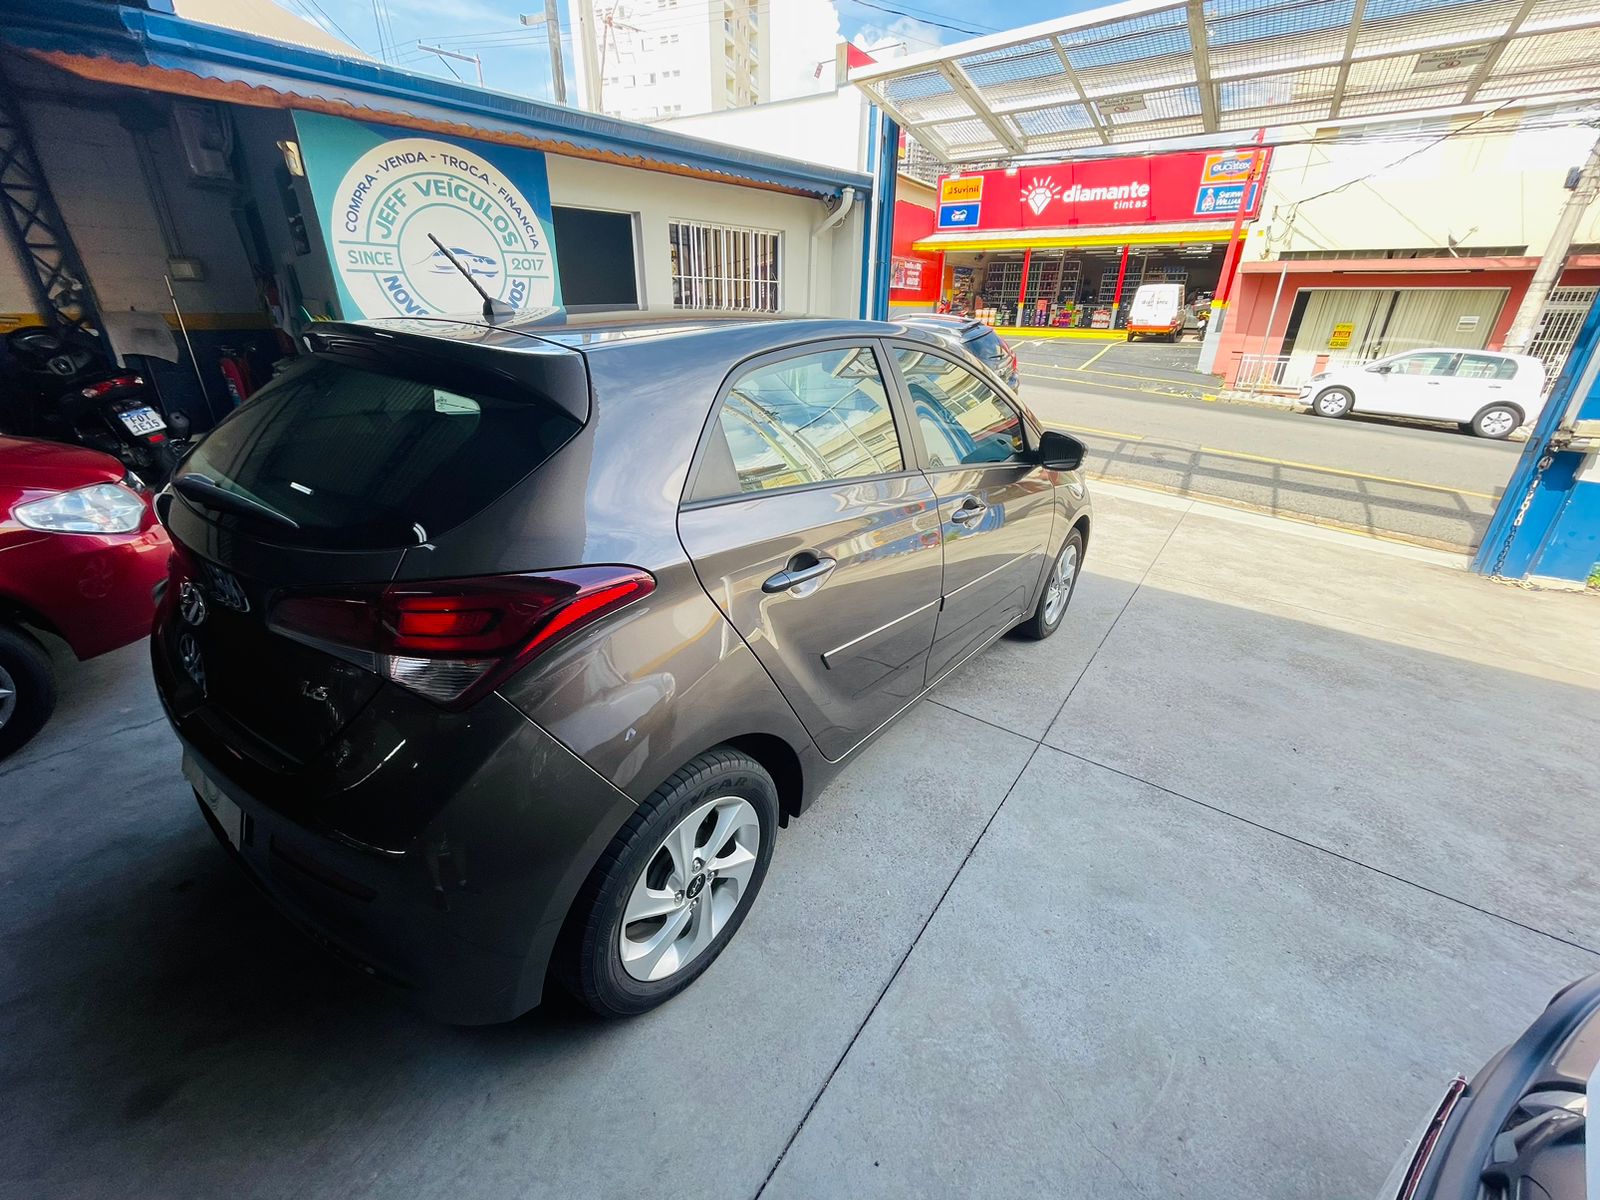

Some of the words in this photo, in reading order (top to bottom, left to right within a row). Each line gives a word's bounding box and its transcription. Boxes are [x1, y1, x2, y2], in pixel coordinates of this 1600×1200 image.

[345, 173, 378, 233] COMPRA
[378, 151, 429, 173] VENDA
[440, 153, 490, 186] TROCA
[497, 186, 540, 250] FINANCIA
[953, 185, 979, 194] Suvinil
[1062, 181, 1150, 203] diamante
[375, 187, 407, 239] JEFF
[412, 177, 519, 247] VEÍCULOS
[1113, 199, 1148, 210] tintas
[347, 249, 394, 266] SINCE
[511, 257, 544, 271] 2017
[133, 419, 161, 434] 1E15
